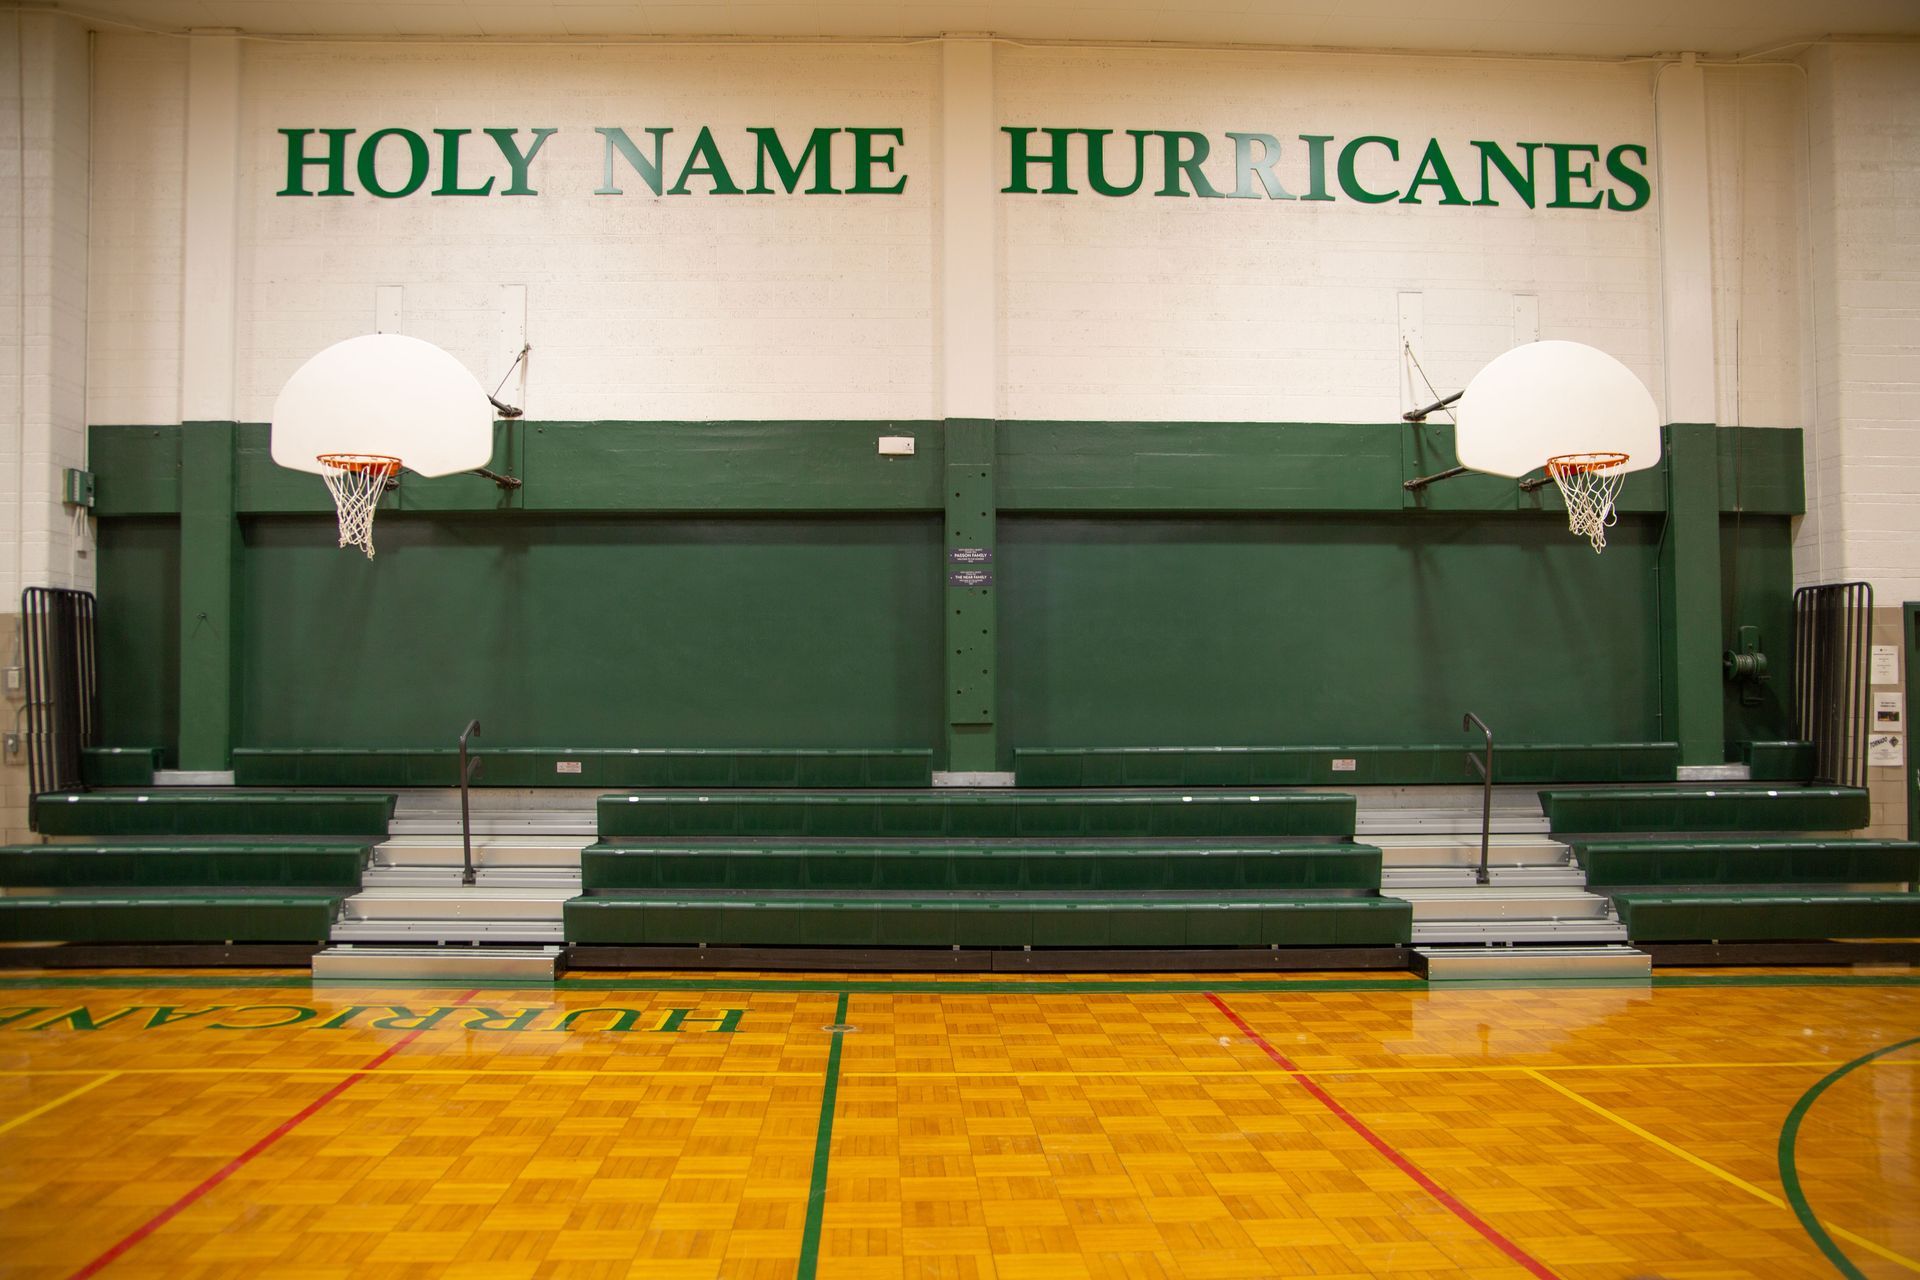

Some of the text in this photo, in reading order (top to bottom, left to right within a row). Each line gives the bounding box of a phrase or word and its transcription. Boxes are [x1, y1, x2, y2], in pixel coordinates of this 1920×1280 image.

[277, 126, 1651, 210] HOLY NAME HURRICANES
